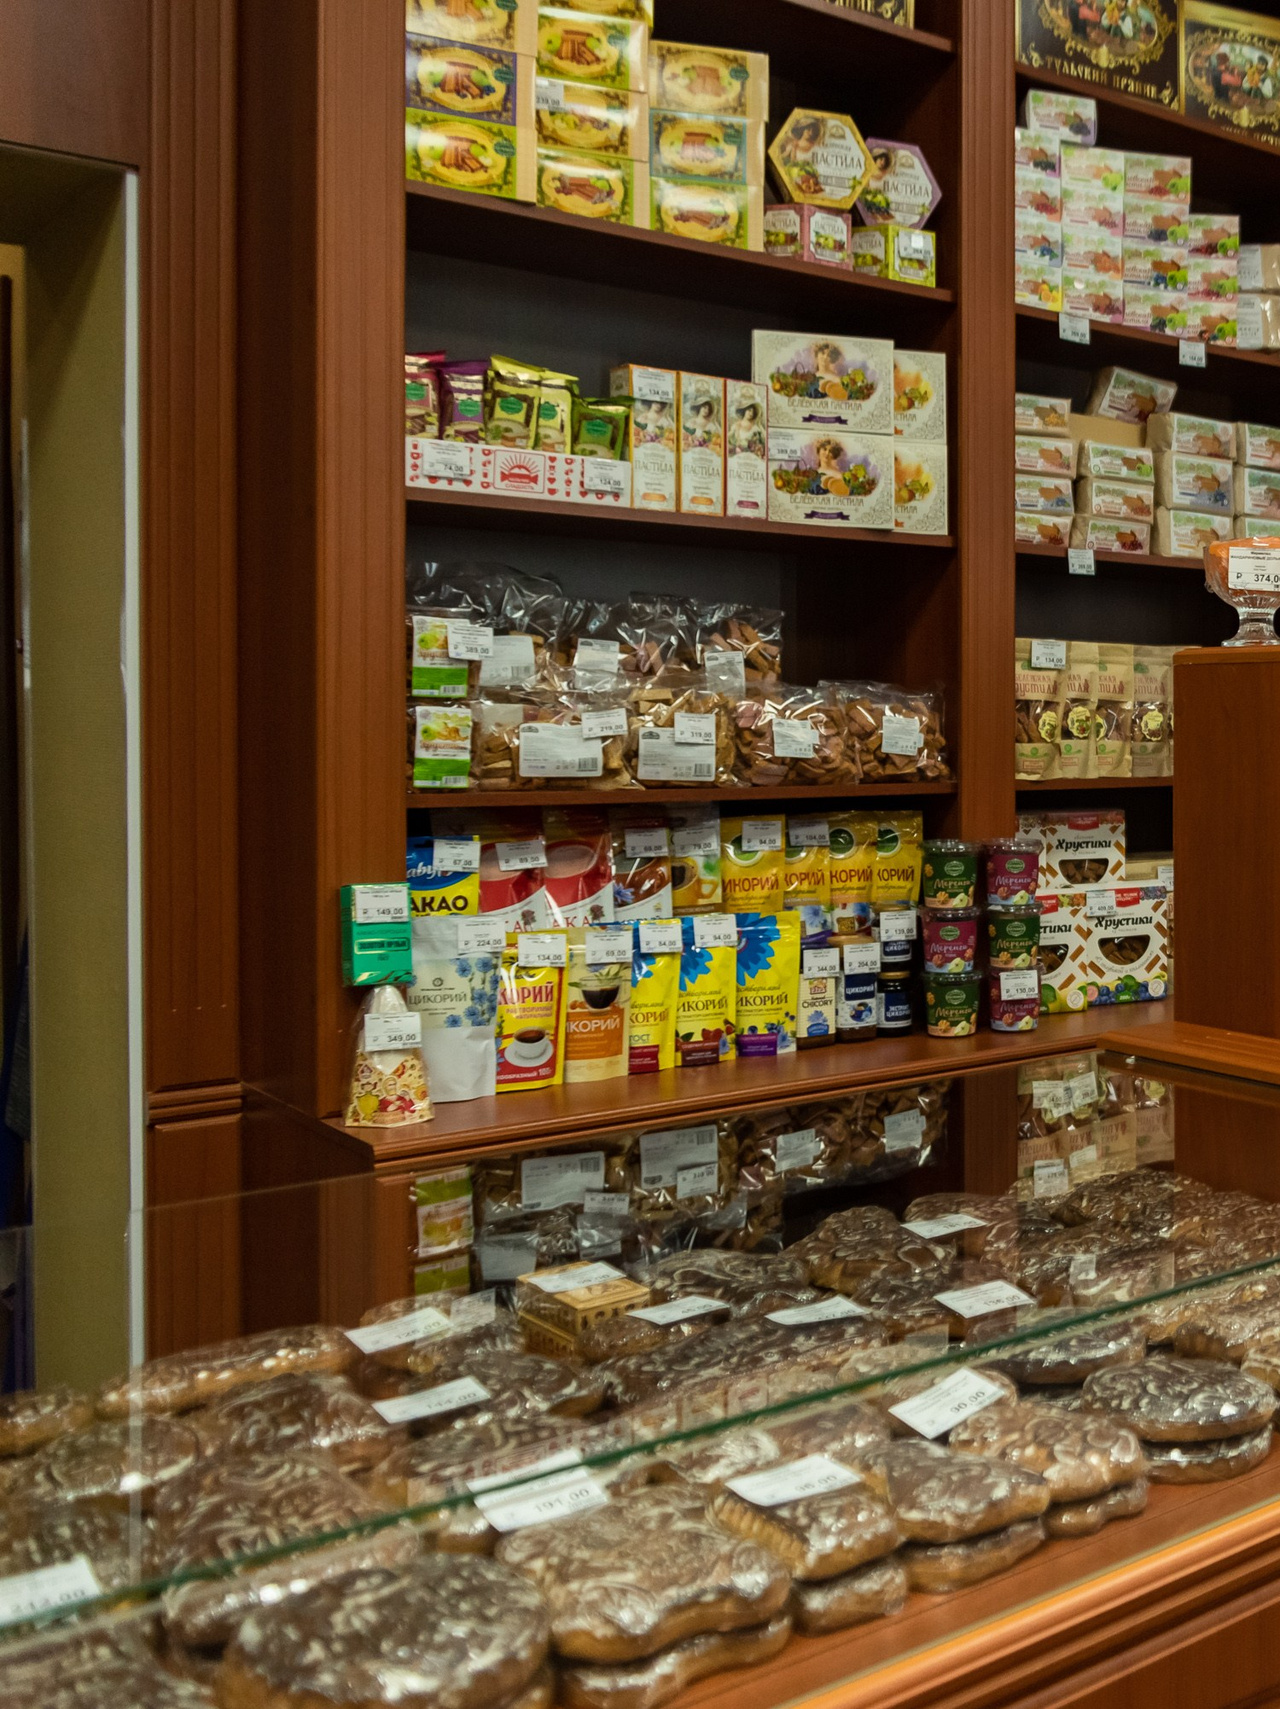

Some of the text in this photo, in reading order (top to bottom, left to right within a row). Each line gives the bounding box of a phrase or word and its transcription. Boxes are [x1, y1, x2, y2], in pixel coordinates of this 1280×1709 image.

[1112, 75, 1158, 100] ПРЯНИК
[811, 151, 863, 170] ПАСТИЛА
[883, 180, 930, 198] ПАСТИЛА
[1056, 838, 1112, 852] Хрустики
[376, 908, 404, 916] 149,00
[1094, 915, 1153, 930] Хрустики
[476, 939, 502, 947] 224,00
[845, 983, 875, 995] ЦИКОРИЙ
[408, 991, 467, 1006] ЦИКОРИЙ
[801, 999, 833, 1009] CHICORY
[387, 1034, 416, 1043] 349,00
[535, 1488, 589, 1513] 191,00
